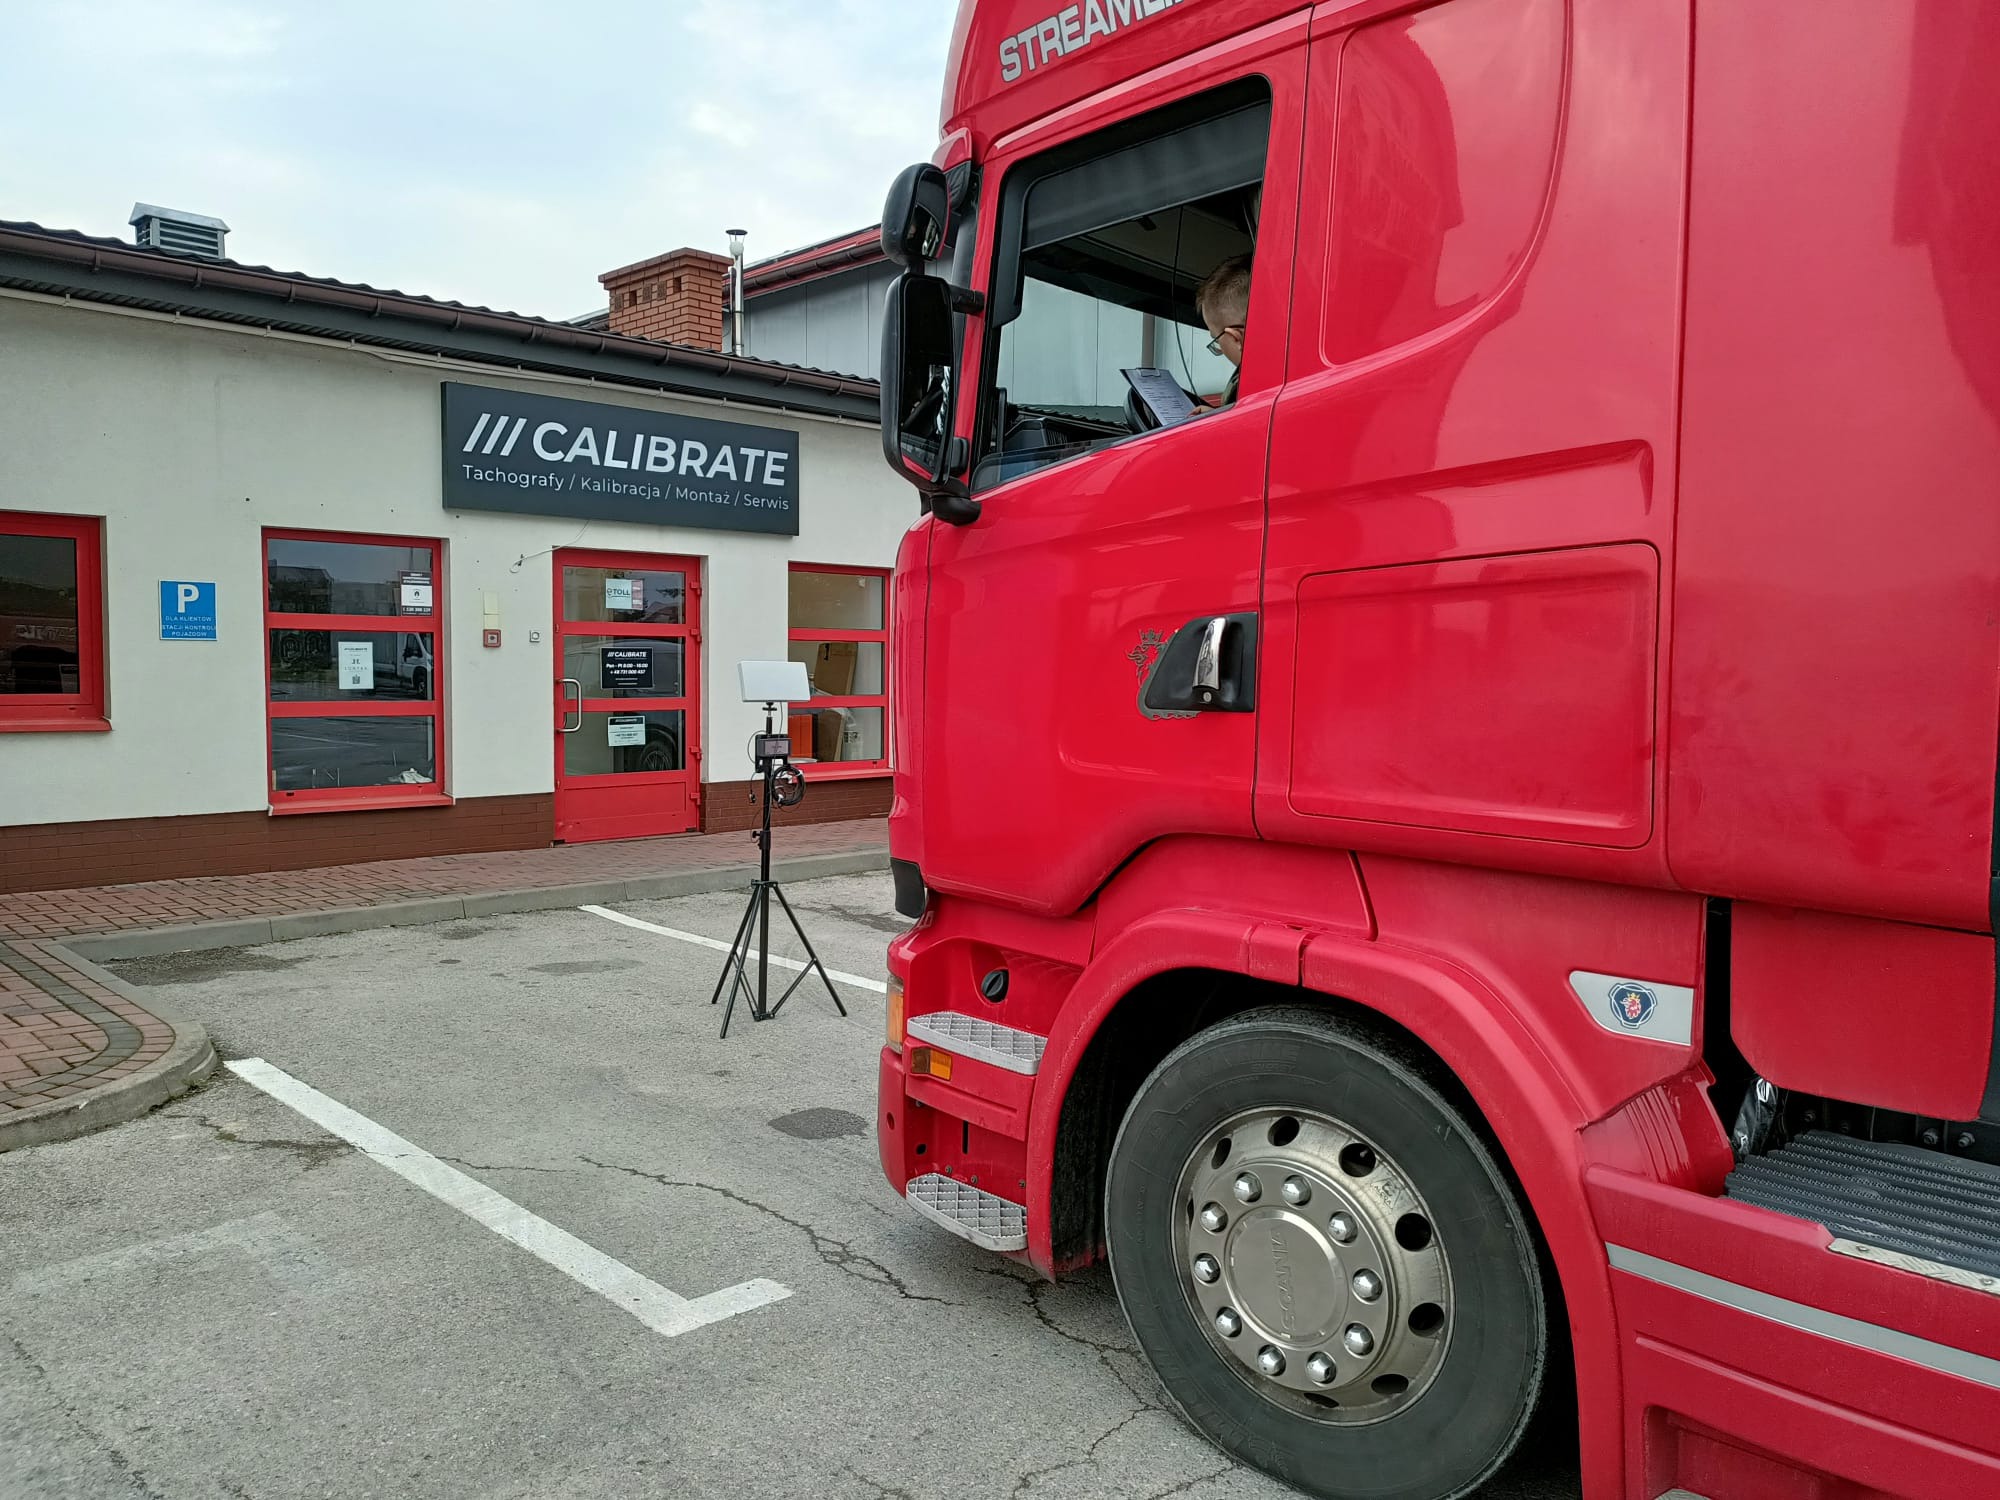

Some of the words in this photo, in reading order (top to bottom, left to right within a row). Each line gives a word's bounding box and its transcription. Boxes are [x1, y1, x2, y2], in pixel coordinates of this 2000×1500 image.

[999, 0, 1184, 83] STREAM
[532, 421, 789, 487] CALIBRATE
[462, 464, 565, 491] Tachografy
[581, 476, 661, 499] Kalibracja
[675, 488, 731, 506] Montaż
[743, 493, 790, 511] Serwis
[177, 584, 200, 614] P
[1270, 1226, 1297, 1332] SCANIA
